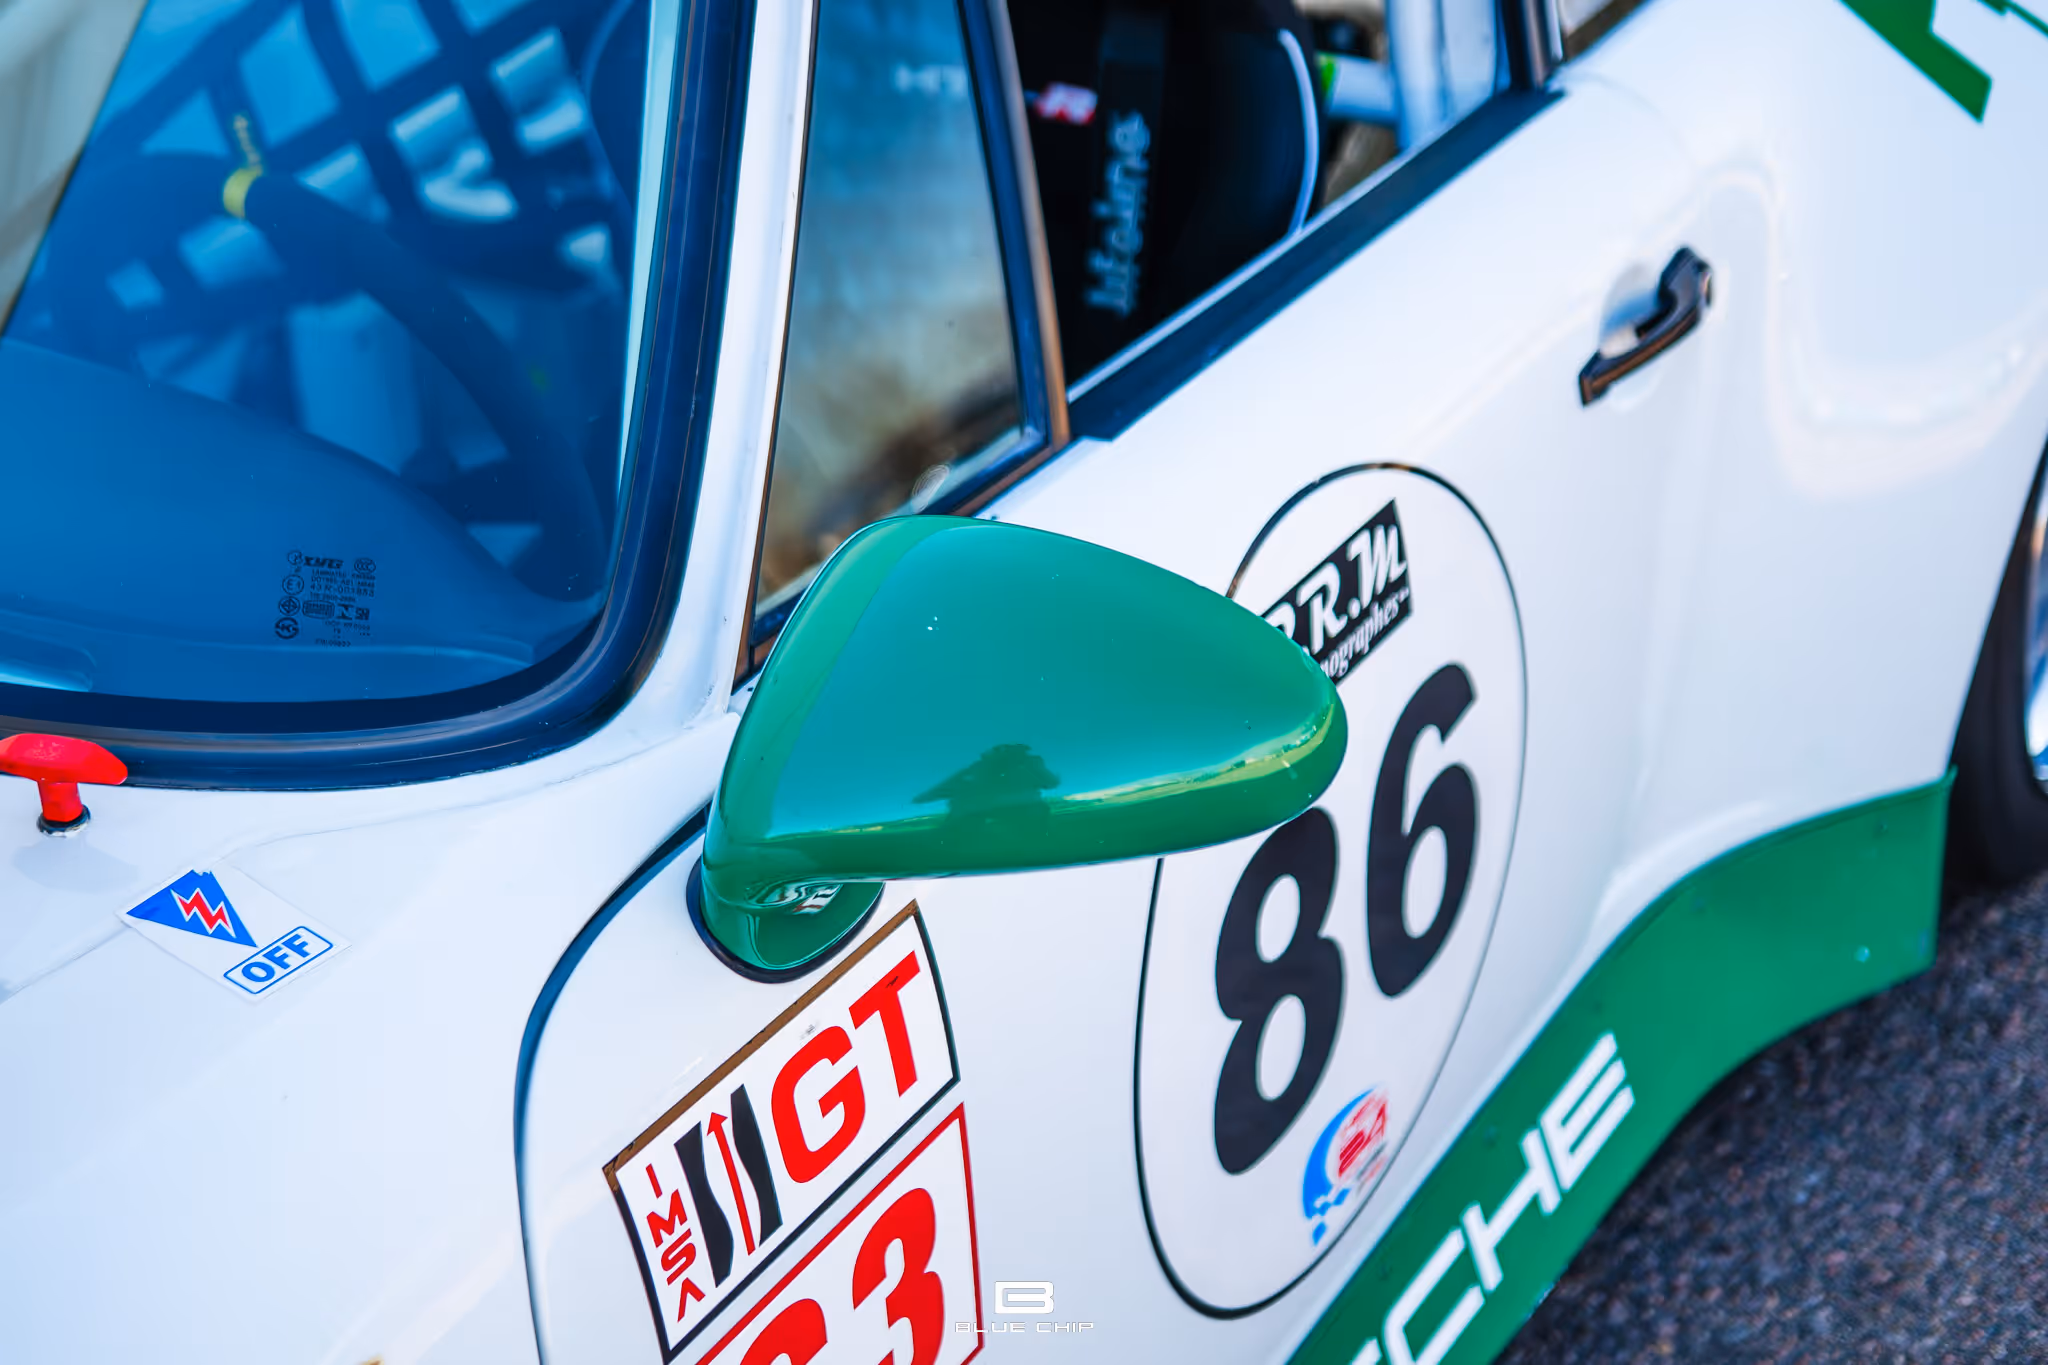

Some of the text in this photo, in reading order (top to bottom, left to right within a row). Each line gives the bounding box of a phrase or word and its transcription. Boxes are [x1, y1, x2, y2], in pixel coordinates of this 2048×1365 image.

[241, 934, 310, 982] OFF
[1214, 661, 1480, 1176] 86
[771, 950, 920, 1184] GT
[646, 1163, 706, 1323] IMSA
[1350, 1032, 1635, 1365] CHE
